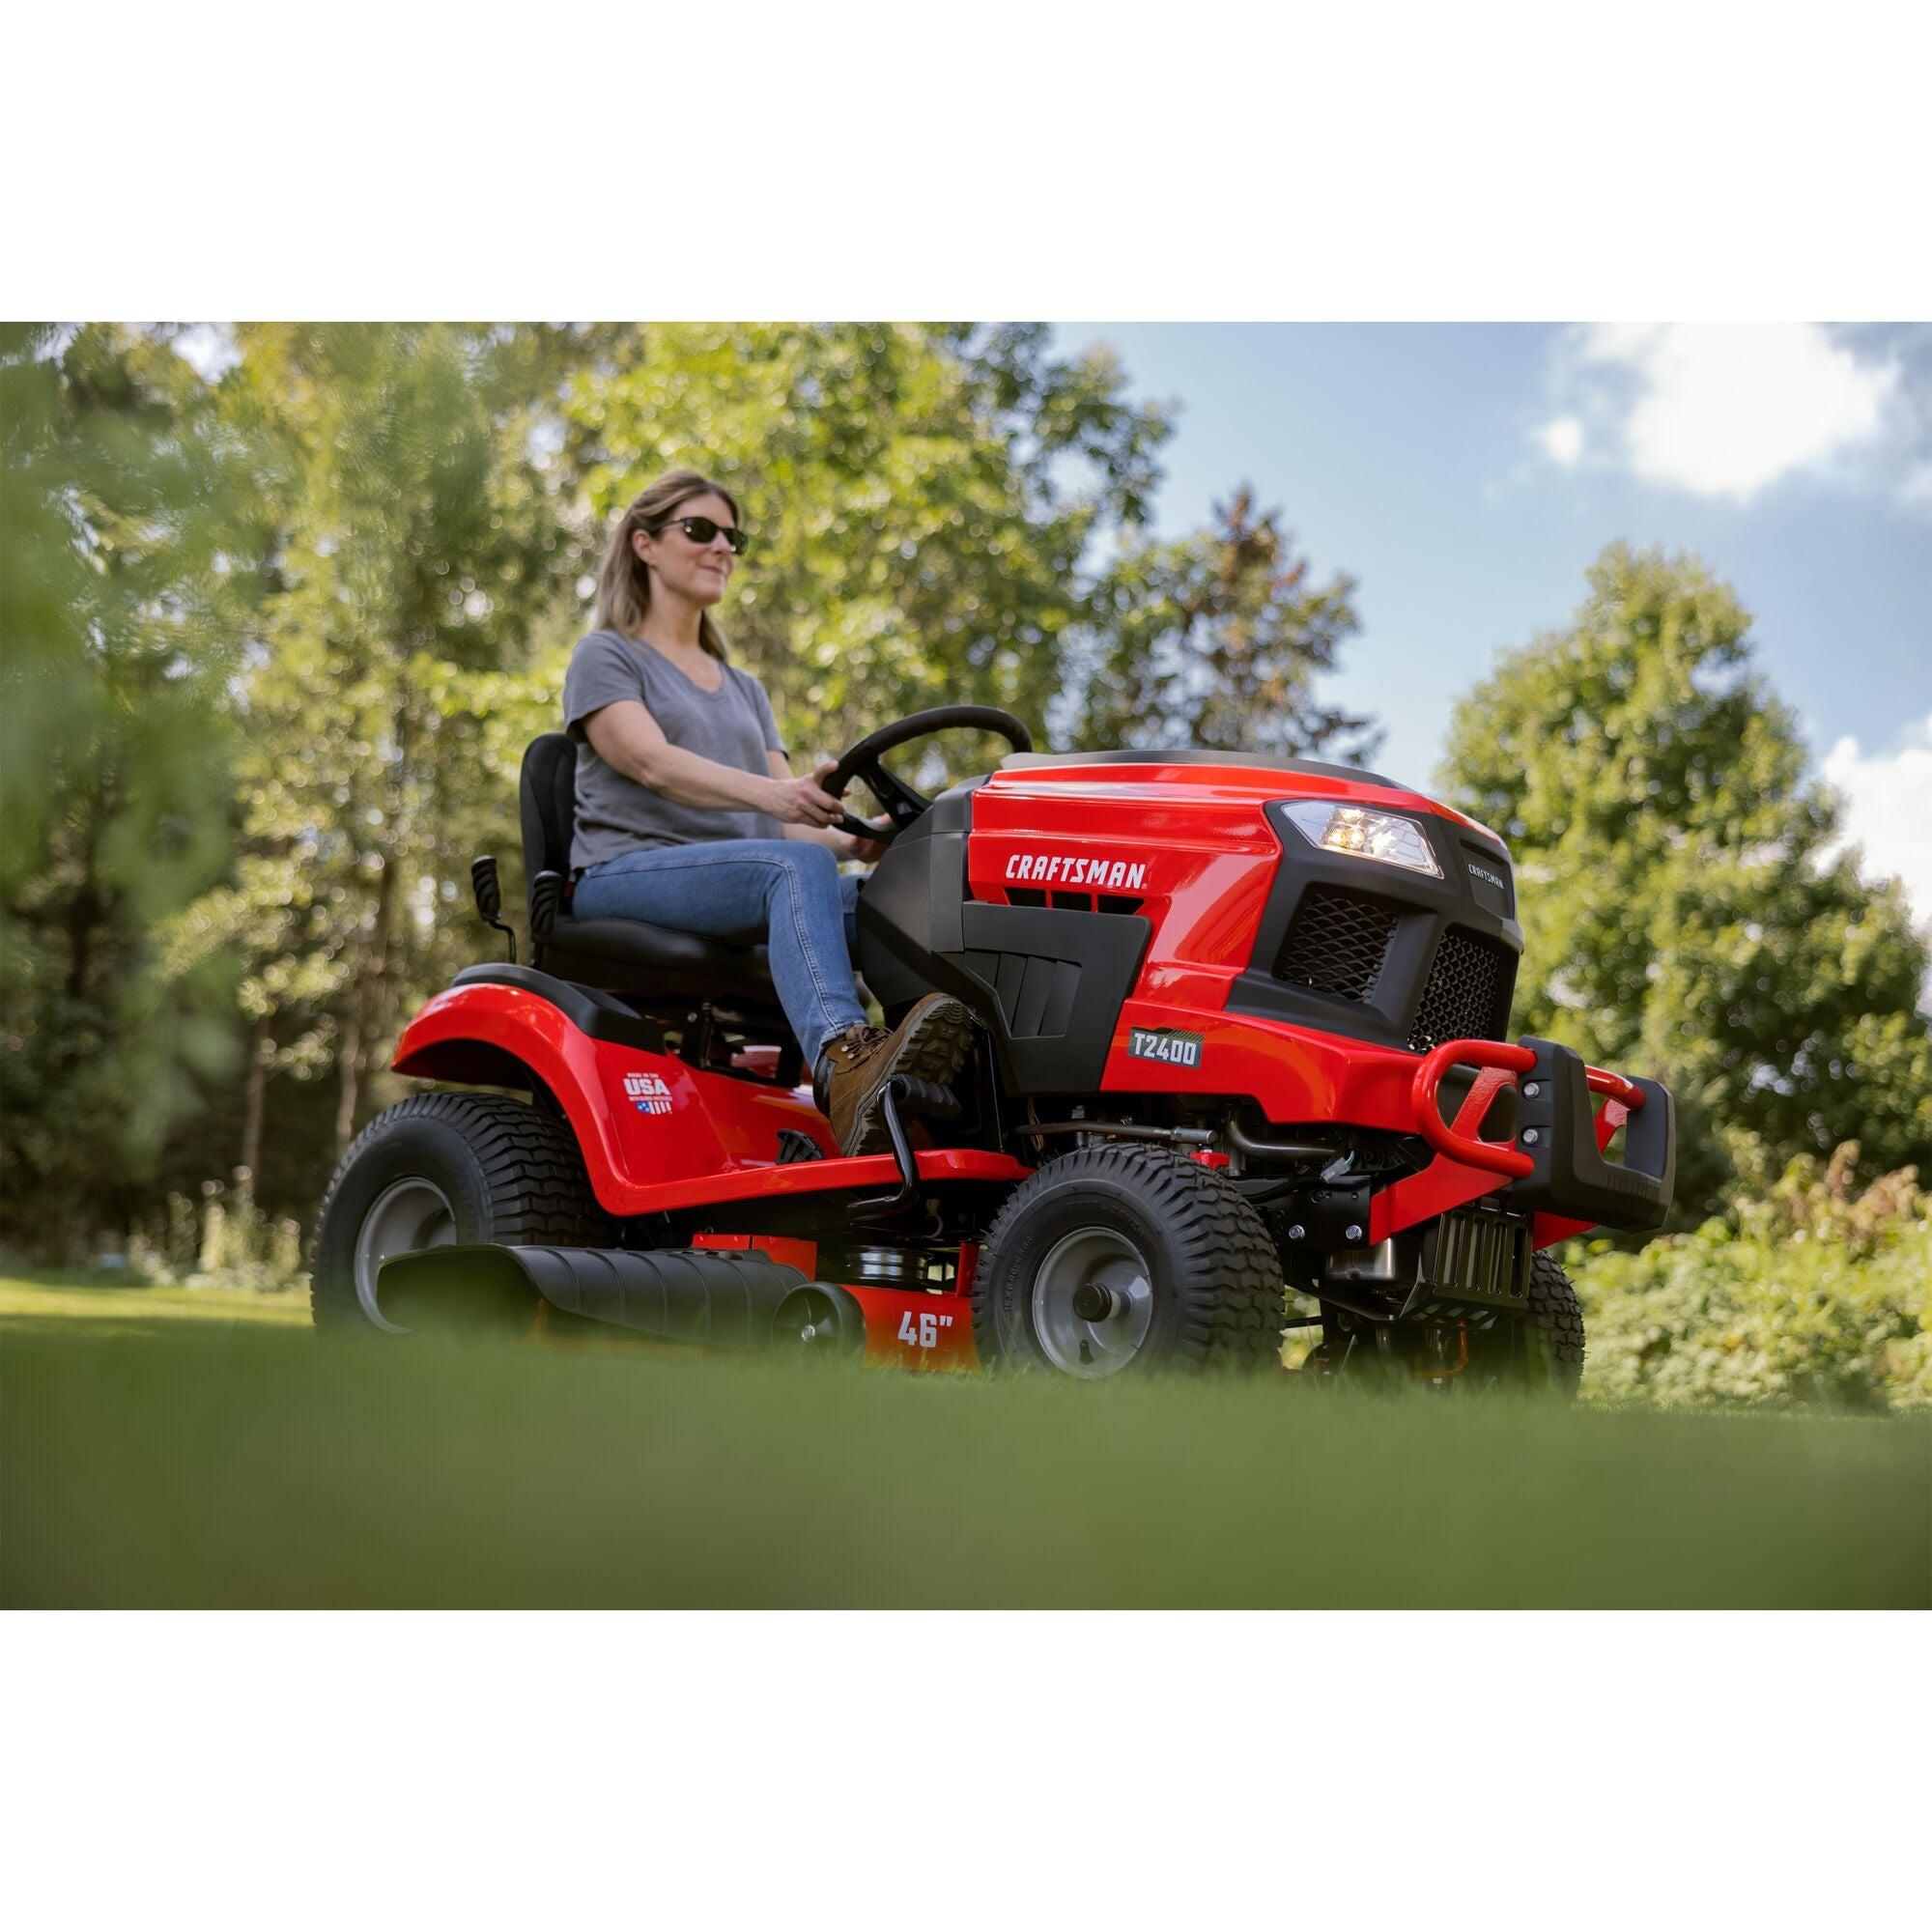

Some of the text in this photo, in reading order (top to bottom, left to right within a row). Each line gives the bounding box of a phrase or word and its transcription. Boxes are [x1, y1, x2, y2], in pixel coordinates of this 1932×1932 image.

[1006, 854, 1146, 890] CRAFTSMAN
[1468, 864, 1504, 889] CRAFTSMAN
[1134, 1032, 1197, 1065] T2400
[623, 1078, 671, 1095] USA
[897, 1311, 953, 1349] 46"
